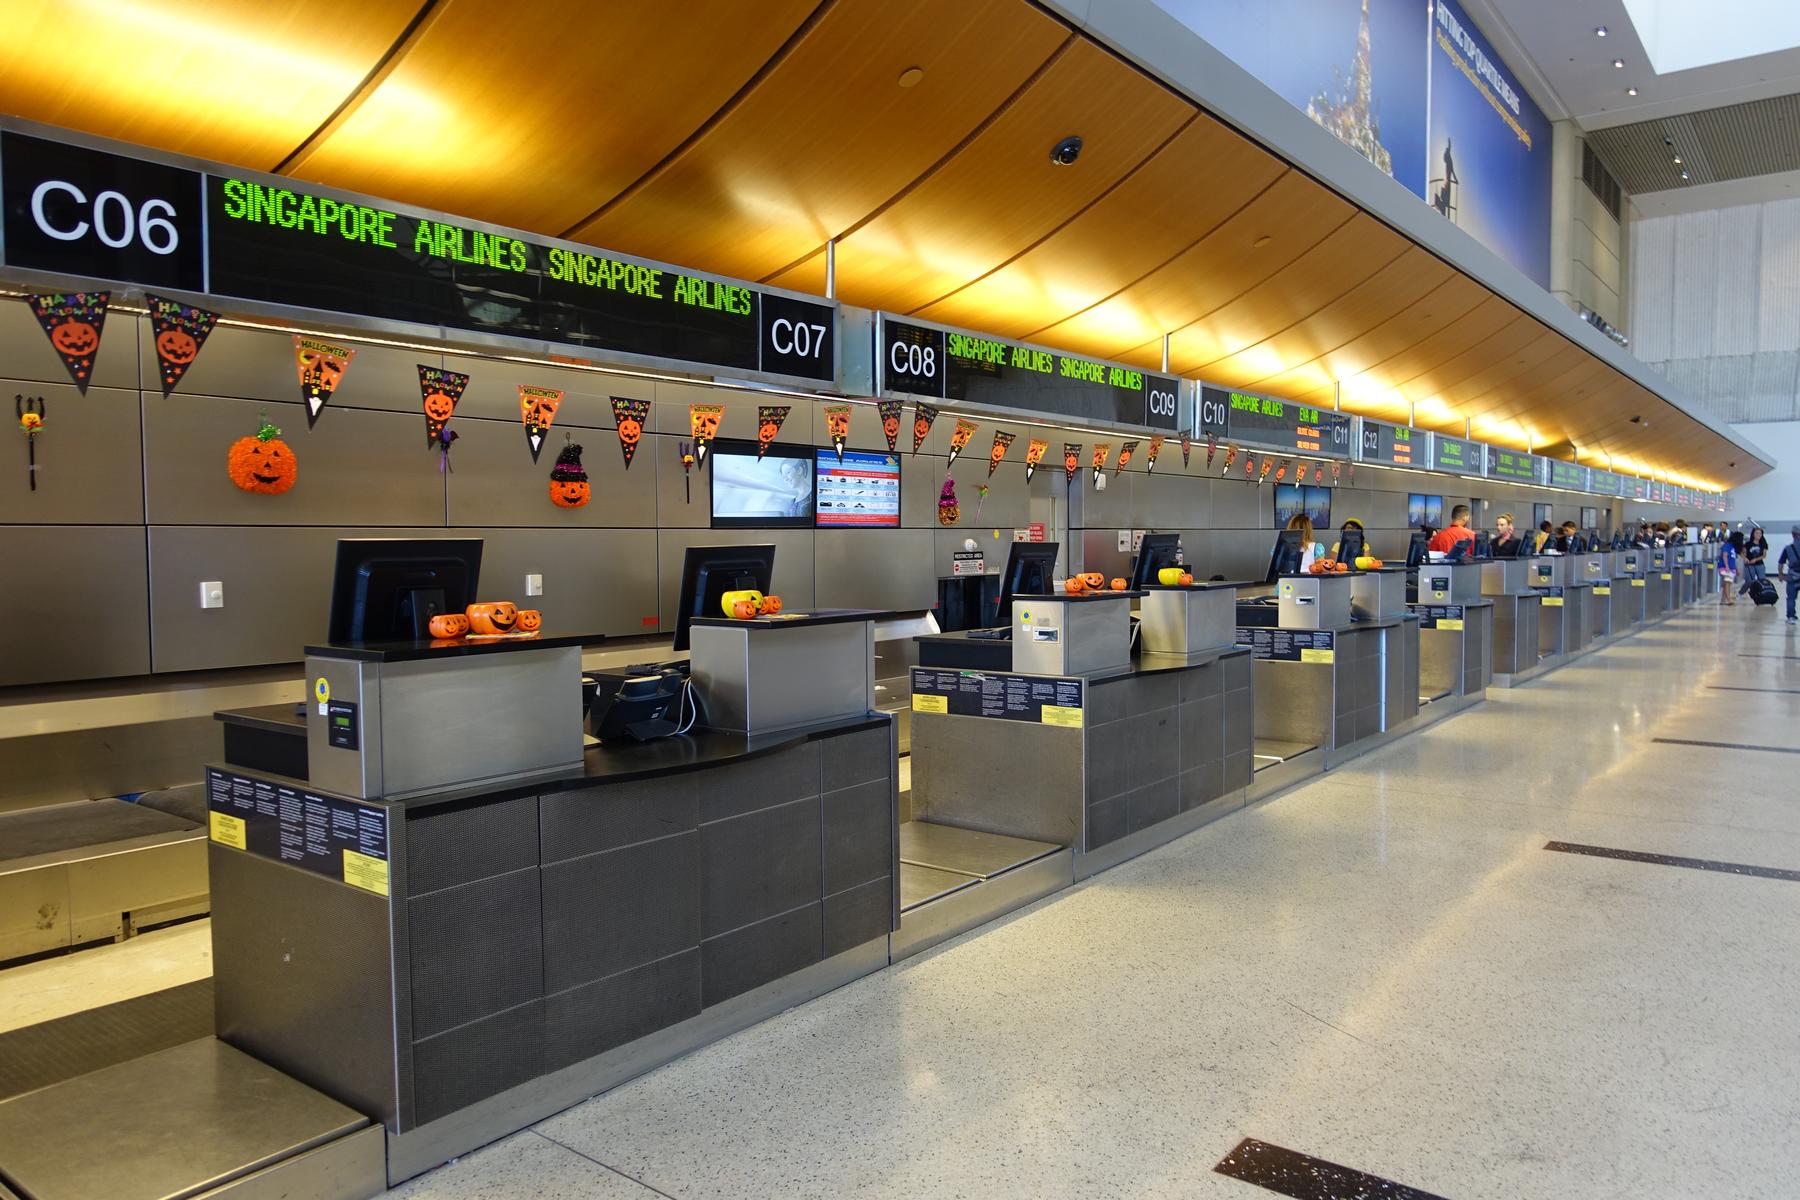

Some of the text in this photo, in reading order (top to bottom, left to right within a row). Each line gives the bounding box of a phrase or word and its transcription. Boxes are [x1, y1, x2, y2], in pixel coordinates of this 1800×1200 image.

[31, 180, 179, 255] C06
[223, 177, 752, 316] SINGAPORE AIRLINES SINGAPORE AIRLINES
[39, 292, 98, 308] HAPPY
[158, 301, 209, 324] HAPPY
[300, 340, 349, 359] HALLOWEEN
[771, 318, 827, 358] C07
[890, 341, 936, 378] C08
[948, 333, 1143, 391] SINGAPORE AIRLINES SINGAPORE AIRLINES
[1149, 390, 1175, 417] C09
[1203, 400, 1225, 425] C10
[1230, 392, 1284, 417] SINGAPORE AIRLINES
[1299, 406, 1320, 424] EVA AIR
[1334, 425, 1348, 444] C11
[1363, 431, 1378, 449] C12
